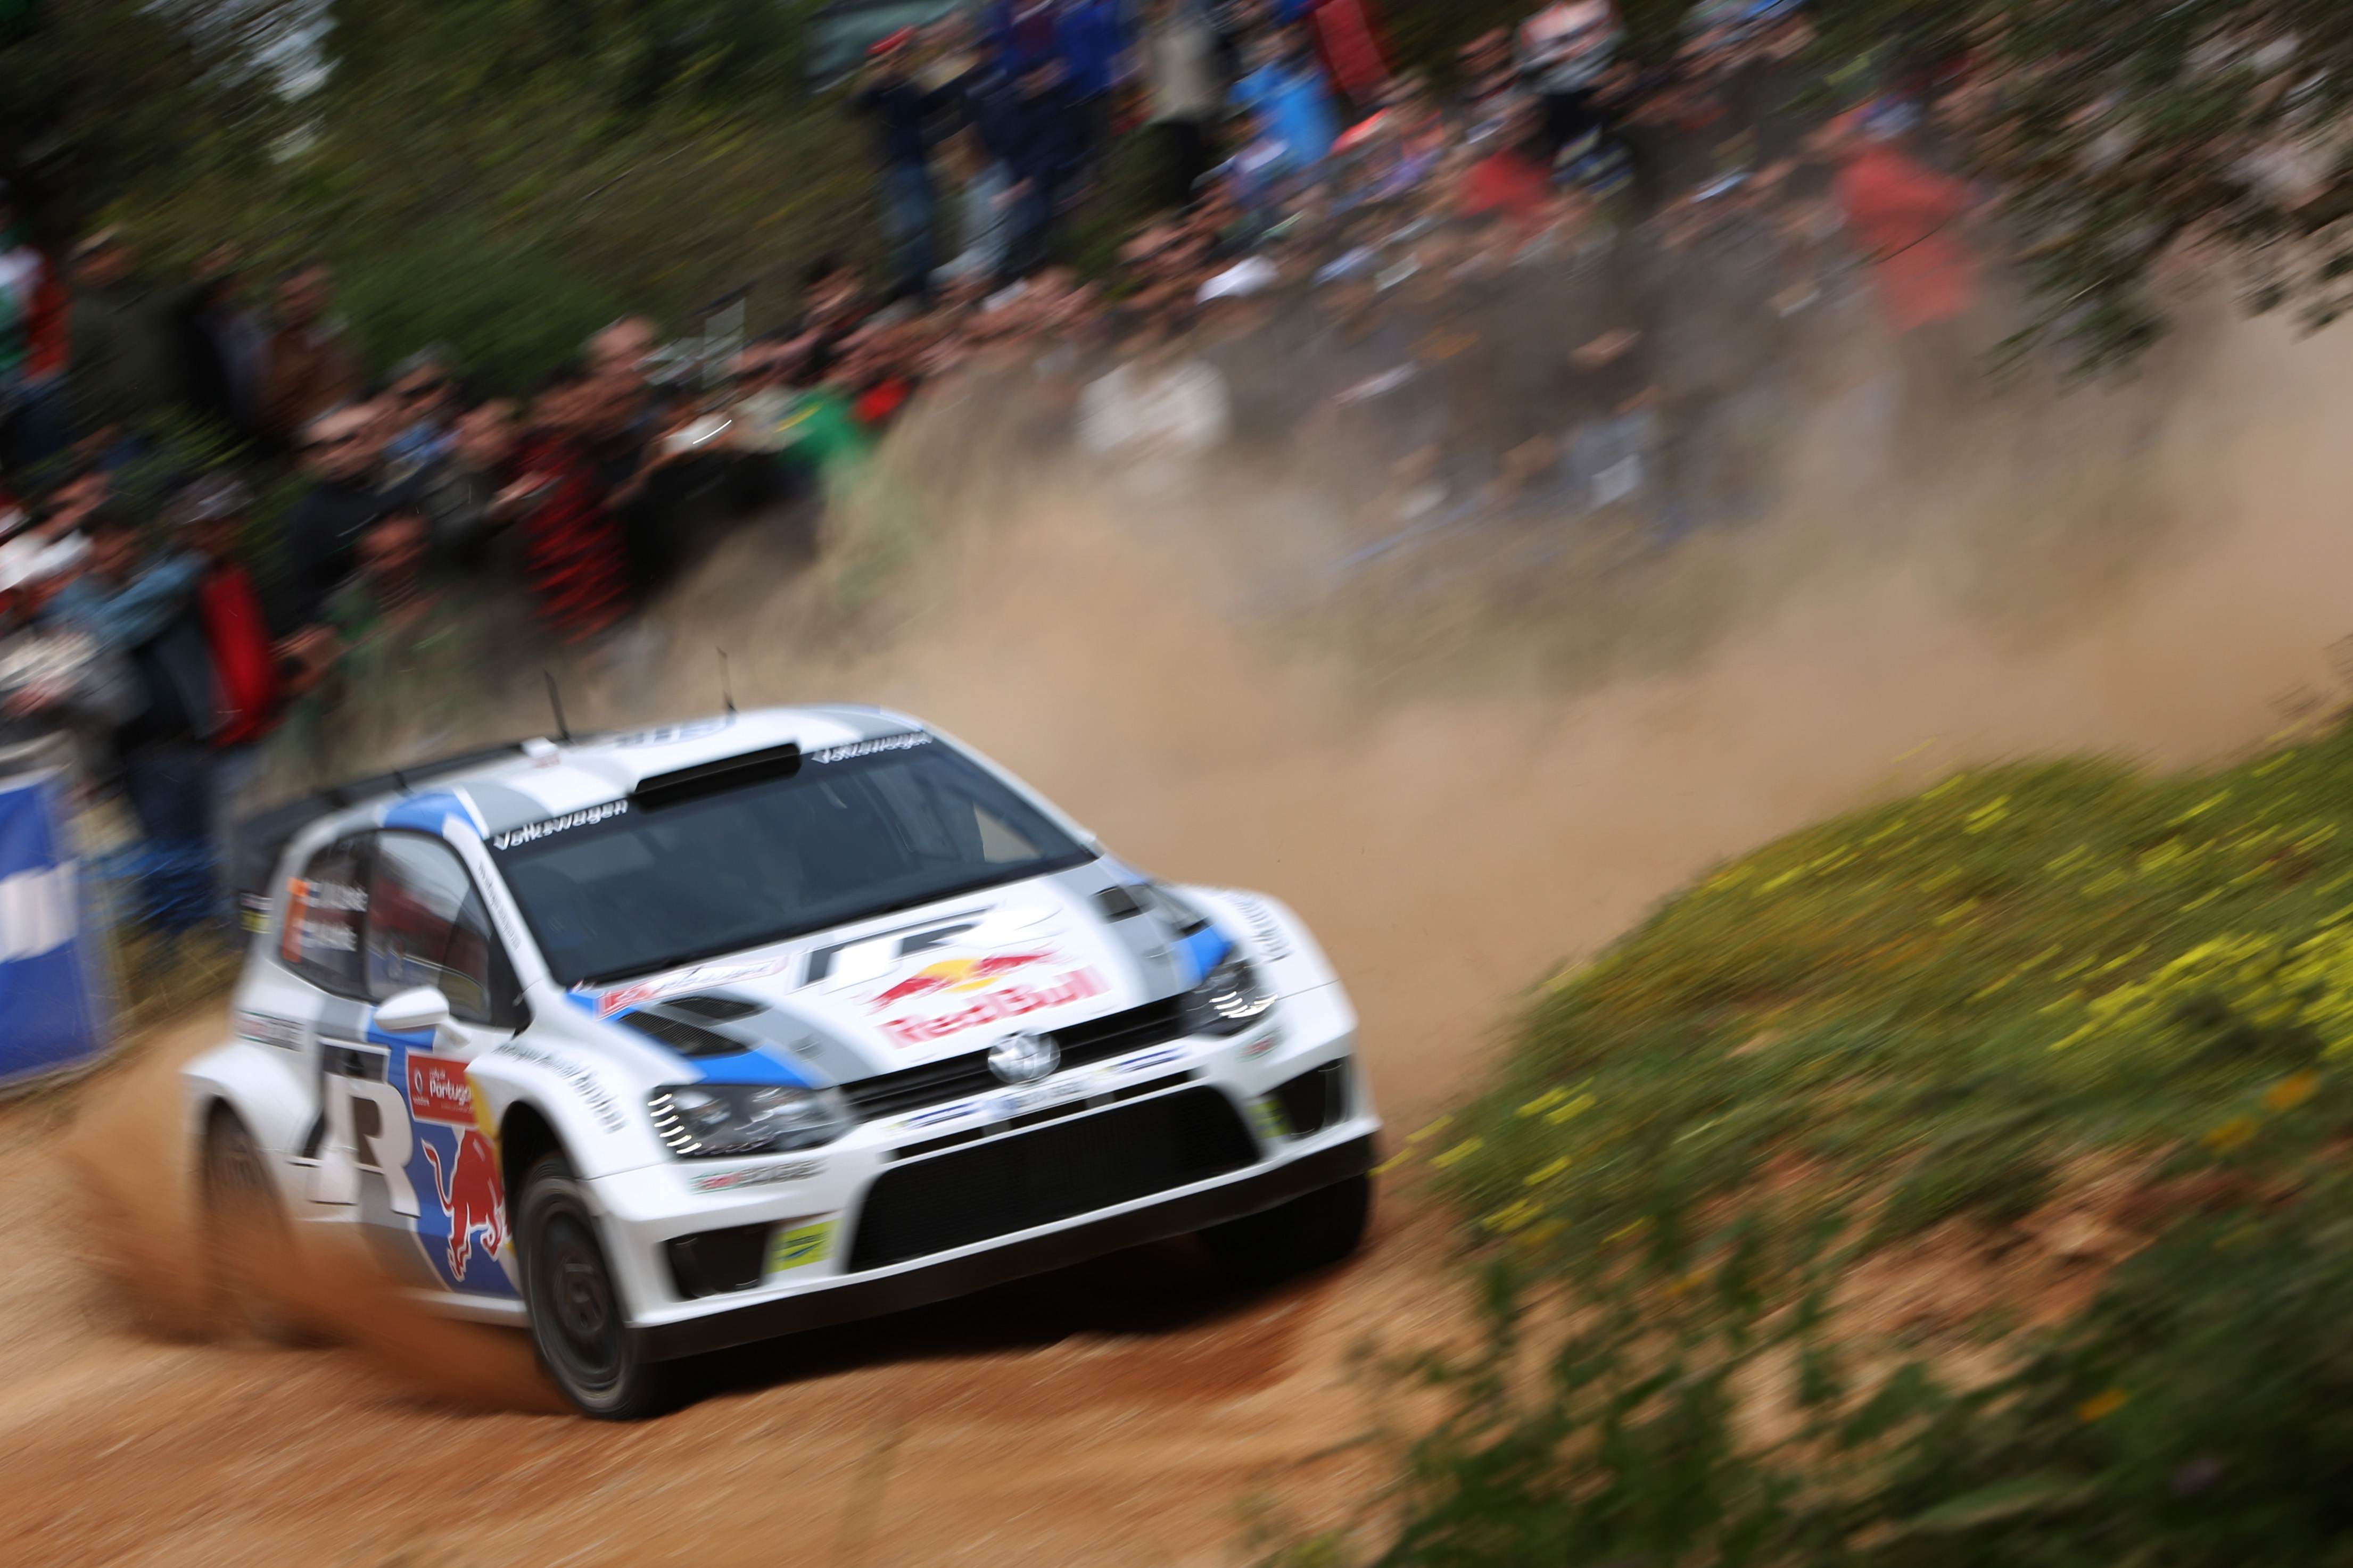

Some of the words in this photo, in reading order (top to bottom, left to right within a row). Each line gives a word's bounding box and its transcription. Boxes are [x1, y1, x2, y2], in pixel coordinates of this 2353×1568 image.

[811, 731, 932, 764] Volkswagen
[493, 798, 629, 850] Volkswagen
[873, 999, 1003, 1050] Red
[986, 964, 1114, 1017] Bull
[430, 1078, 472, 1106] Portuga
[308, 1070, 422, 1217] R
